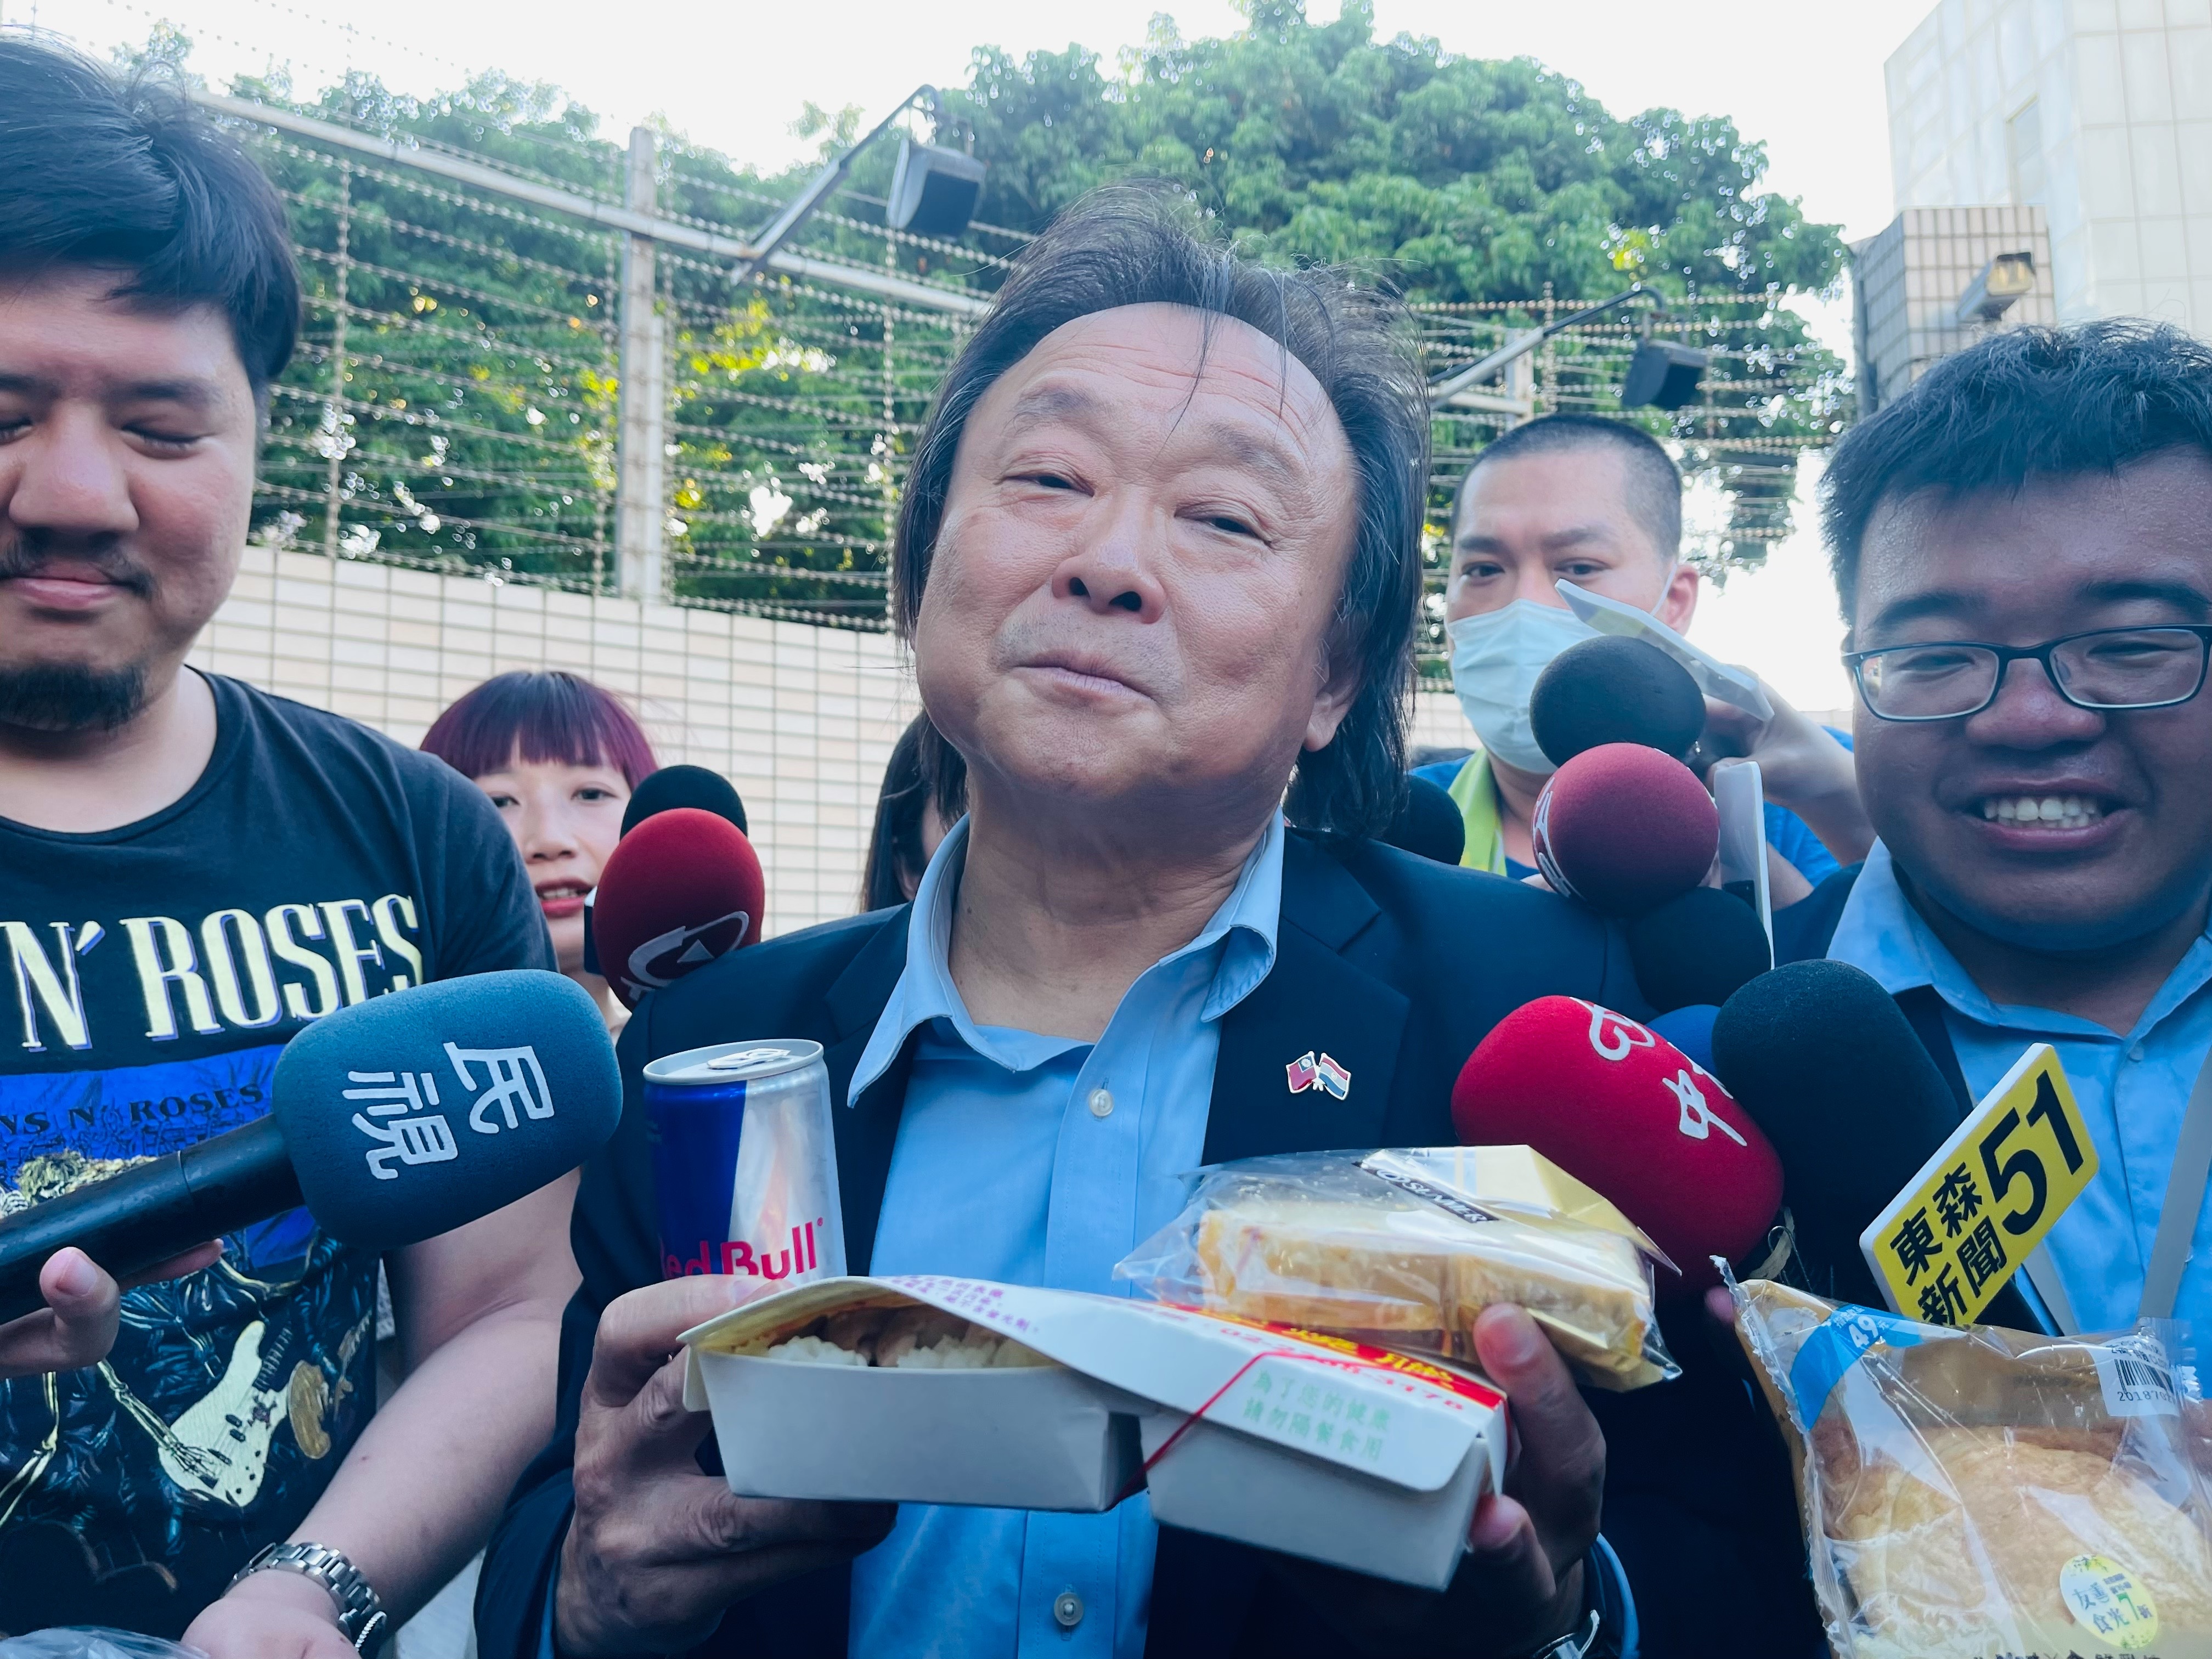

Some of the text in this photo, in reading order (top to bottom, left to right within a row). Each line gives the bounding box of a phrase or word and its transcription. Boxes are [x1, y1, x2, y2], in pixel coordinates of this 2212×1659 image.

[119, 894, 424, 1041] ROSES
[129, 1083, 264, 1127] ROSES
[342, 1041, 555, 1181] 民視
[1978, 1069, 2084, 1236] 51
[720, 1221, 817, 1279] Bull
[1890, 1161, 1983, 1287] 東森
[1917, 1215, 2008, 1325] 新聞
[2072, 1582, 2110, 1610] 友善
[2093, 1608, 2130, 1634] 食光
